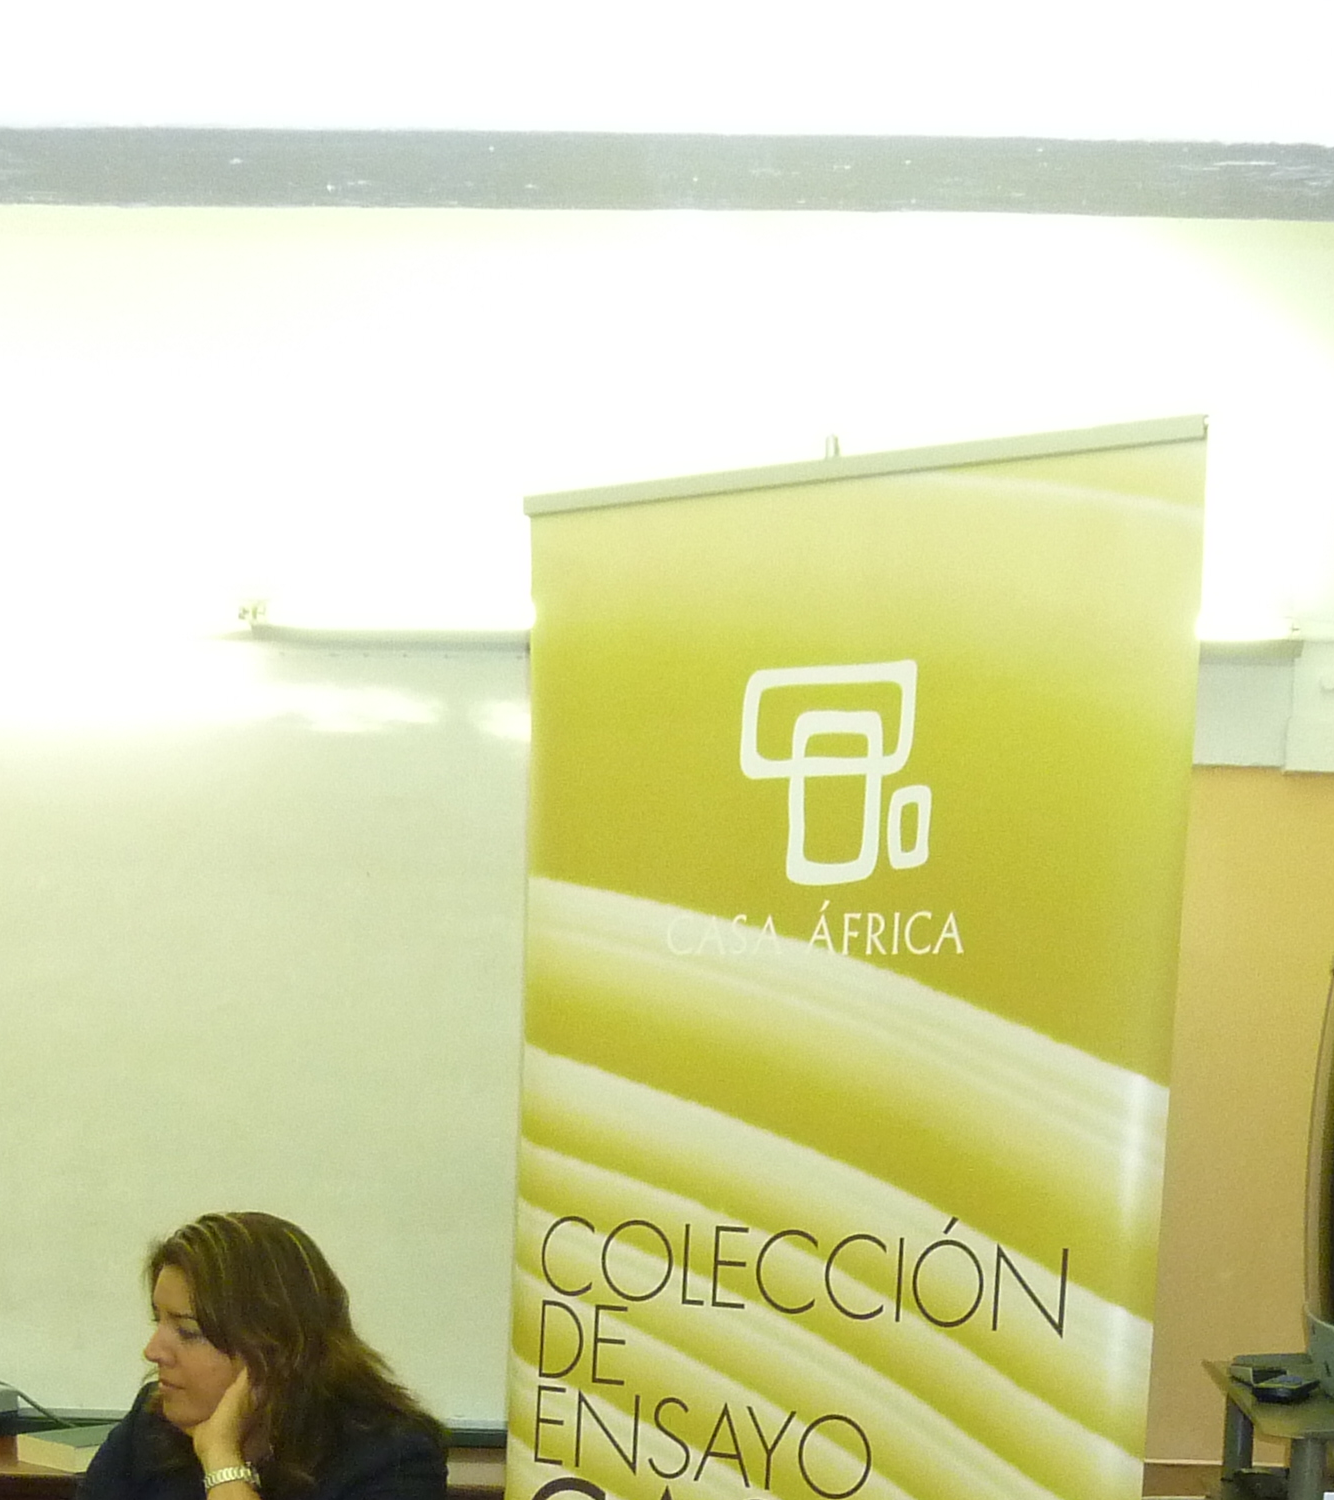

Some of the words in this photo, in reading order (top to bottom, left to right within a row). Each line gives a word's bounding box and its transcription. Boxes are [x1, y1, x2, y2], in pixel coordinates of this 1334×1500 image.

[668, 912, 782, 957] CASA
[806, 900, 965, 956] ÁFRICA
[540, 1215, 1070, 1339] COLECCIÓN
[538, 1299, 629, 1386] DE
[533, 1384, 872, 1500] ENSAYO
